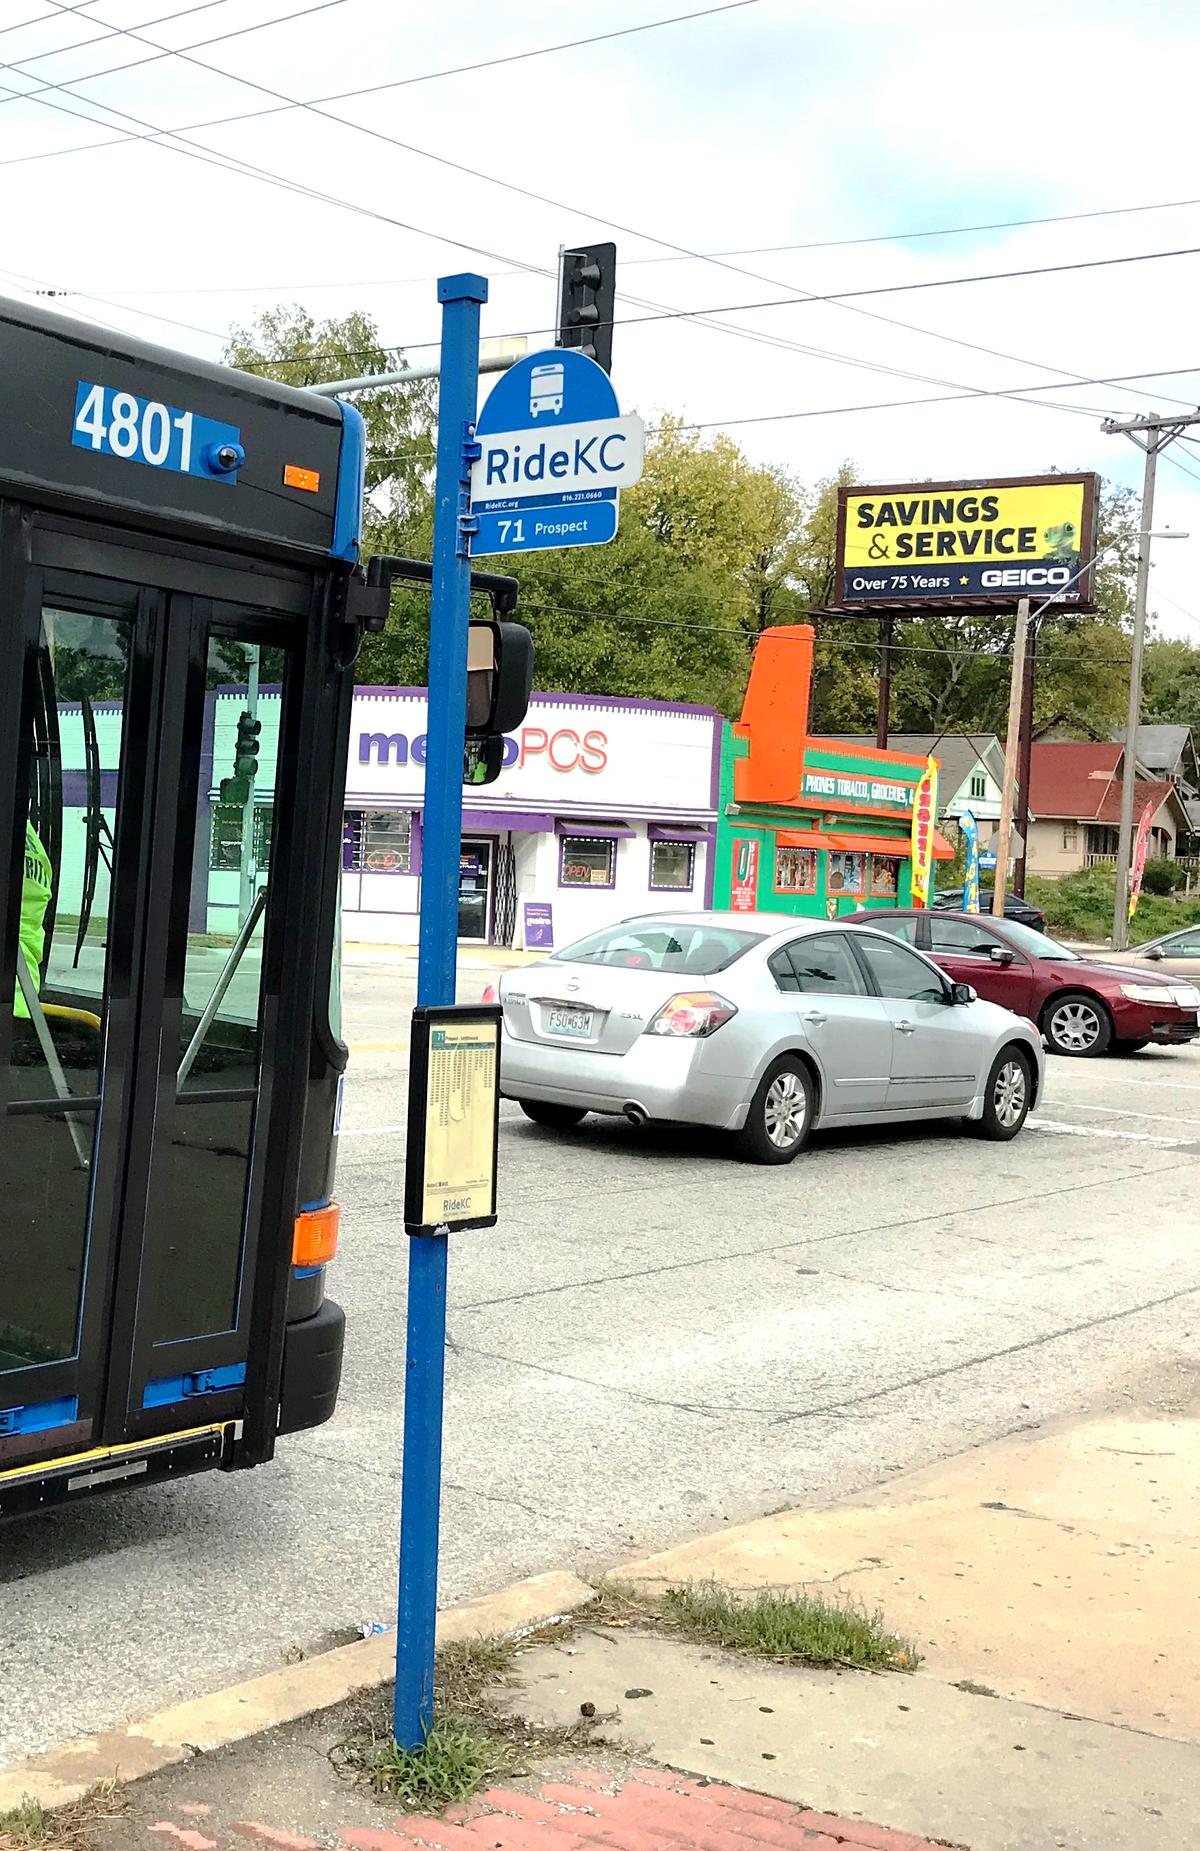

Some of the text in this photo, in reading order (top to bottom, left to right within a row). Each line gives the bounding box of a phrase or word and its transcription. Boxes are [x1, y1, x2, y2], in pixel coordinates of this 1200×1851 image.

[75, 384, 194, 473] 4801
[486, 433, 627, 486] RideKC
[484, 491, 603, 510] RideKC.org 816.221.0660
[857, 495, 1000, 529] SAVINGS
[497, 518, 589, 544] 71 Prospect
[867, 526, 1037, 560] & SERVICE
[852, 566, 1071, 591] Over 75 Years GEICO
[358, 726, 609, 773] meoPCS
[805, 774, 836, 794] PHONES
[837, 778, 870, 801] TOBACCO,
[871, 782, 908, 806] GROCERIES,
[564, 864, 590, 877] OPEN
[443, 1197, 472, 1212] RideKC
